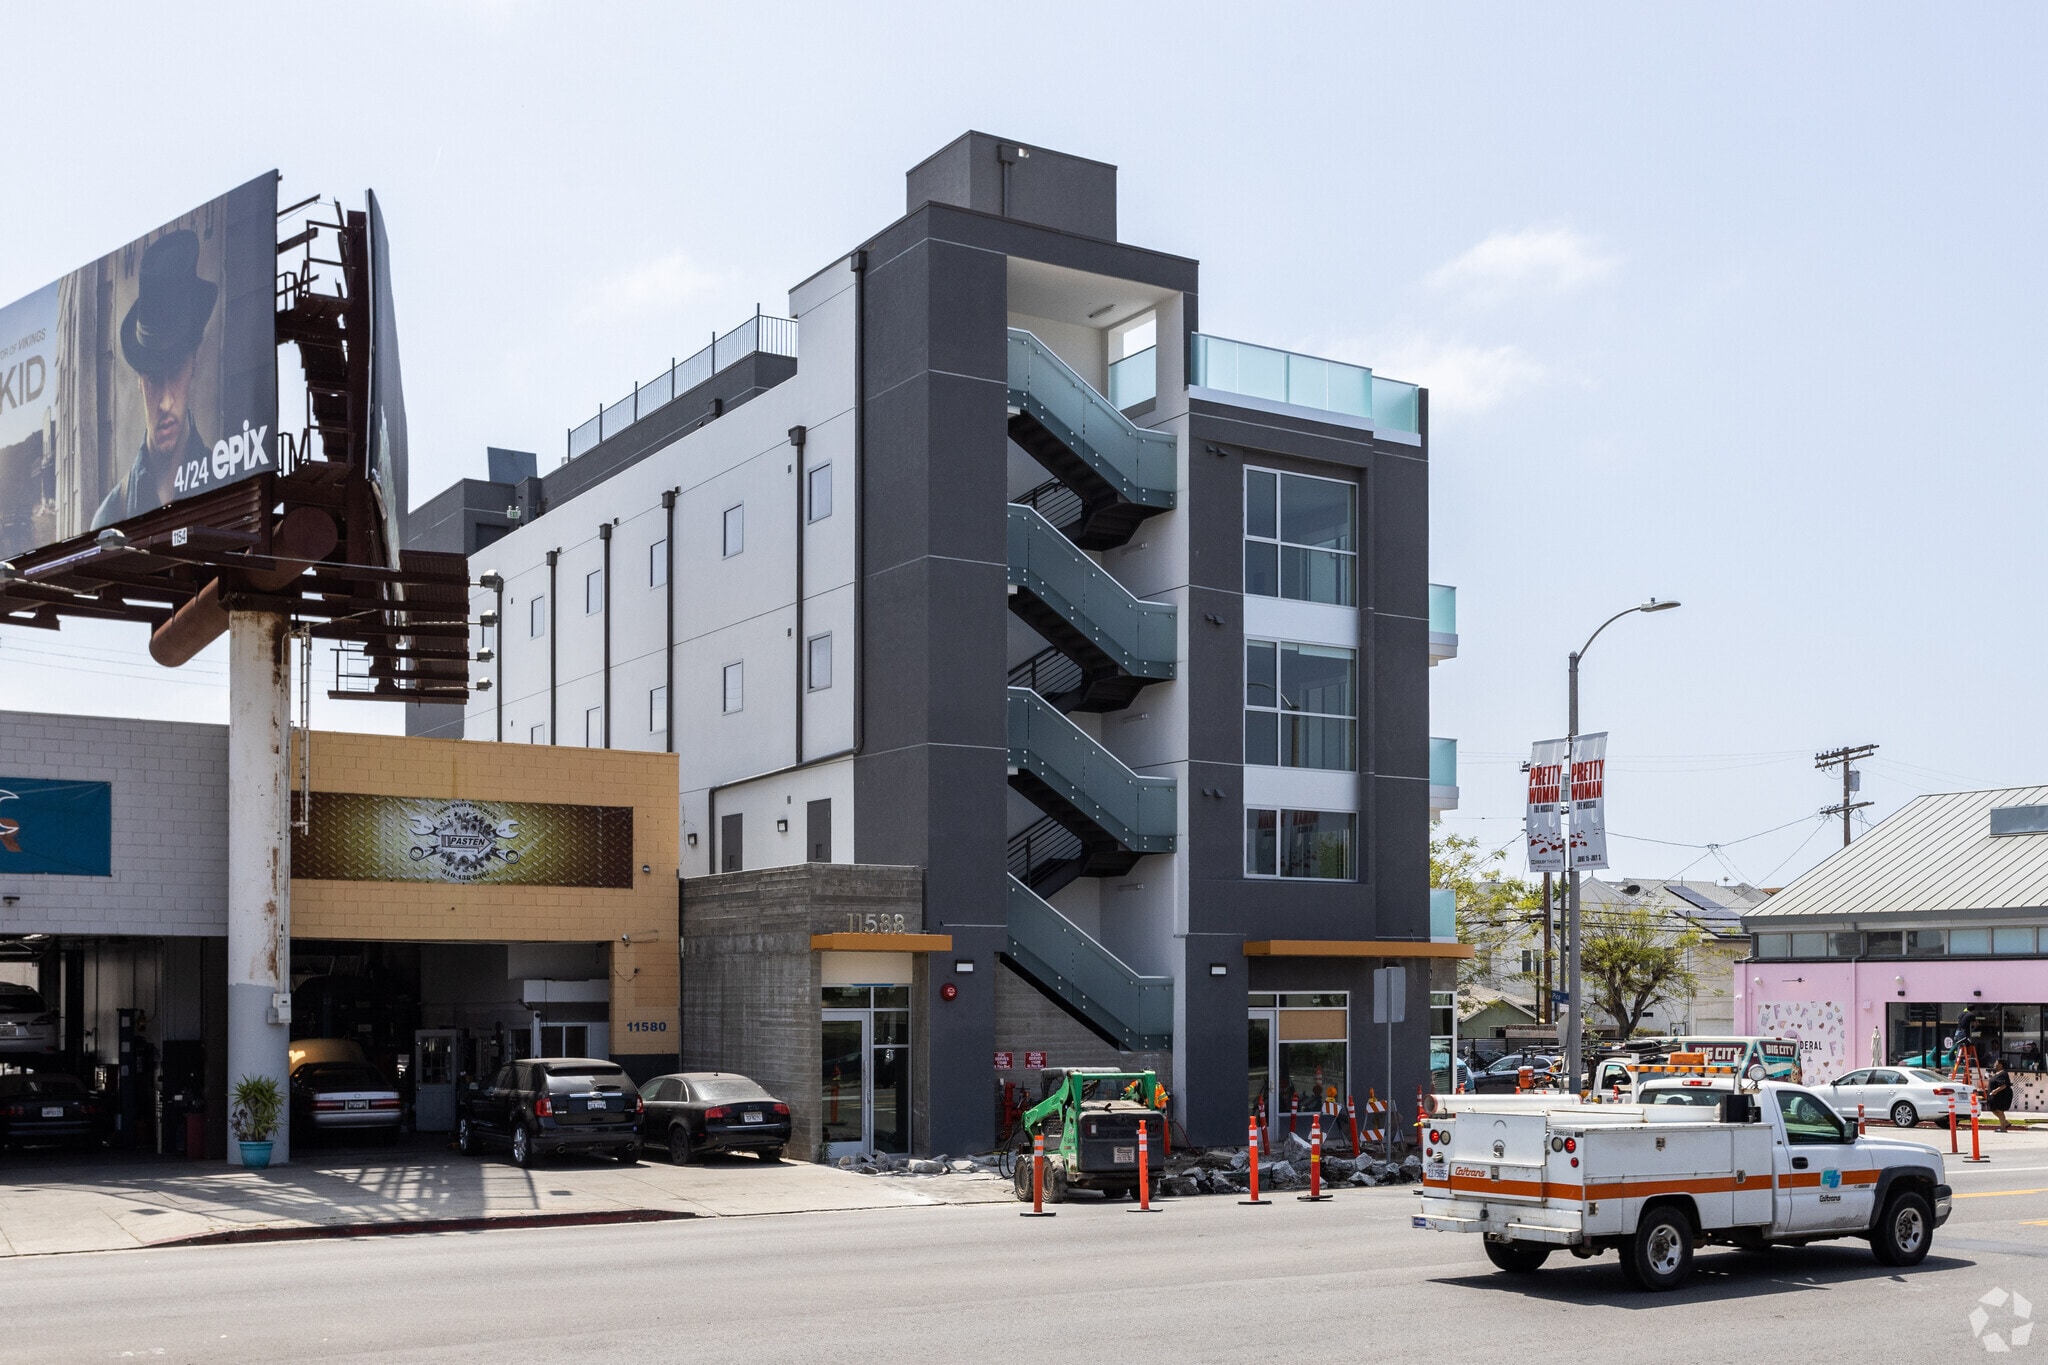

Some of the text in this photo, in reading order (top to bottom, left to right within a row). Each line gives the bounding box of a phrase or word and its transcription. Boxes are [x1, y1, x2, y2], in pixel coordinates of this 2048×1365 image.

[19, 328, 46, 351] VIKINGS
[0, 355, 46, 415] KID
[174, 420, 269, 492] 4/24 epix
[1529, 765, 1562, 786] PRETTY
[1571, 759, 1605, 783] PRETTY
[1529, 785, 1560, 804] WOMAN
[1571, 781, 1602, 801] WOMAN
[451, 838, 485, 846] PASTEN
[847, 913, 905, 934] 11588
[627, 1022, 667, 1032] 11580
[1766, 1044, 1794, 1055] BIG CITY
[1455, 1166, 1486, 1178] Caltrans
